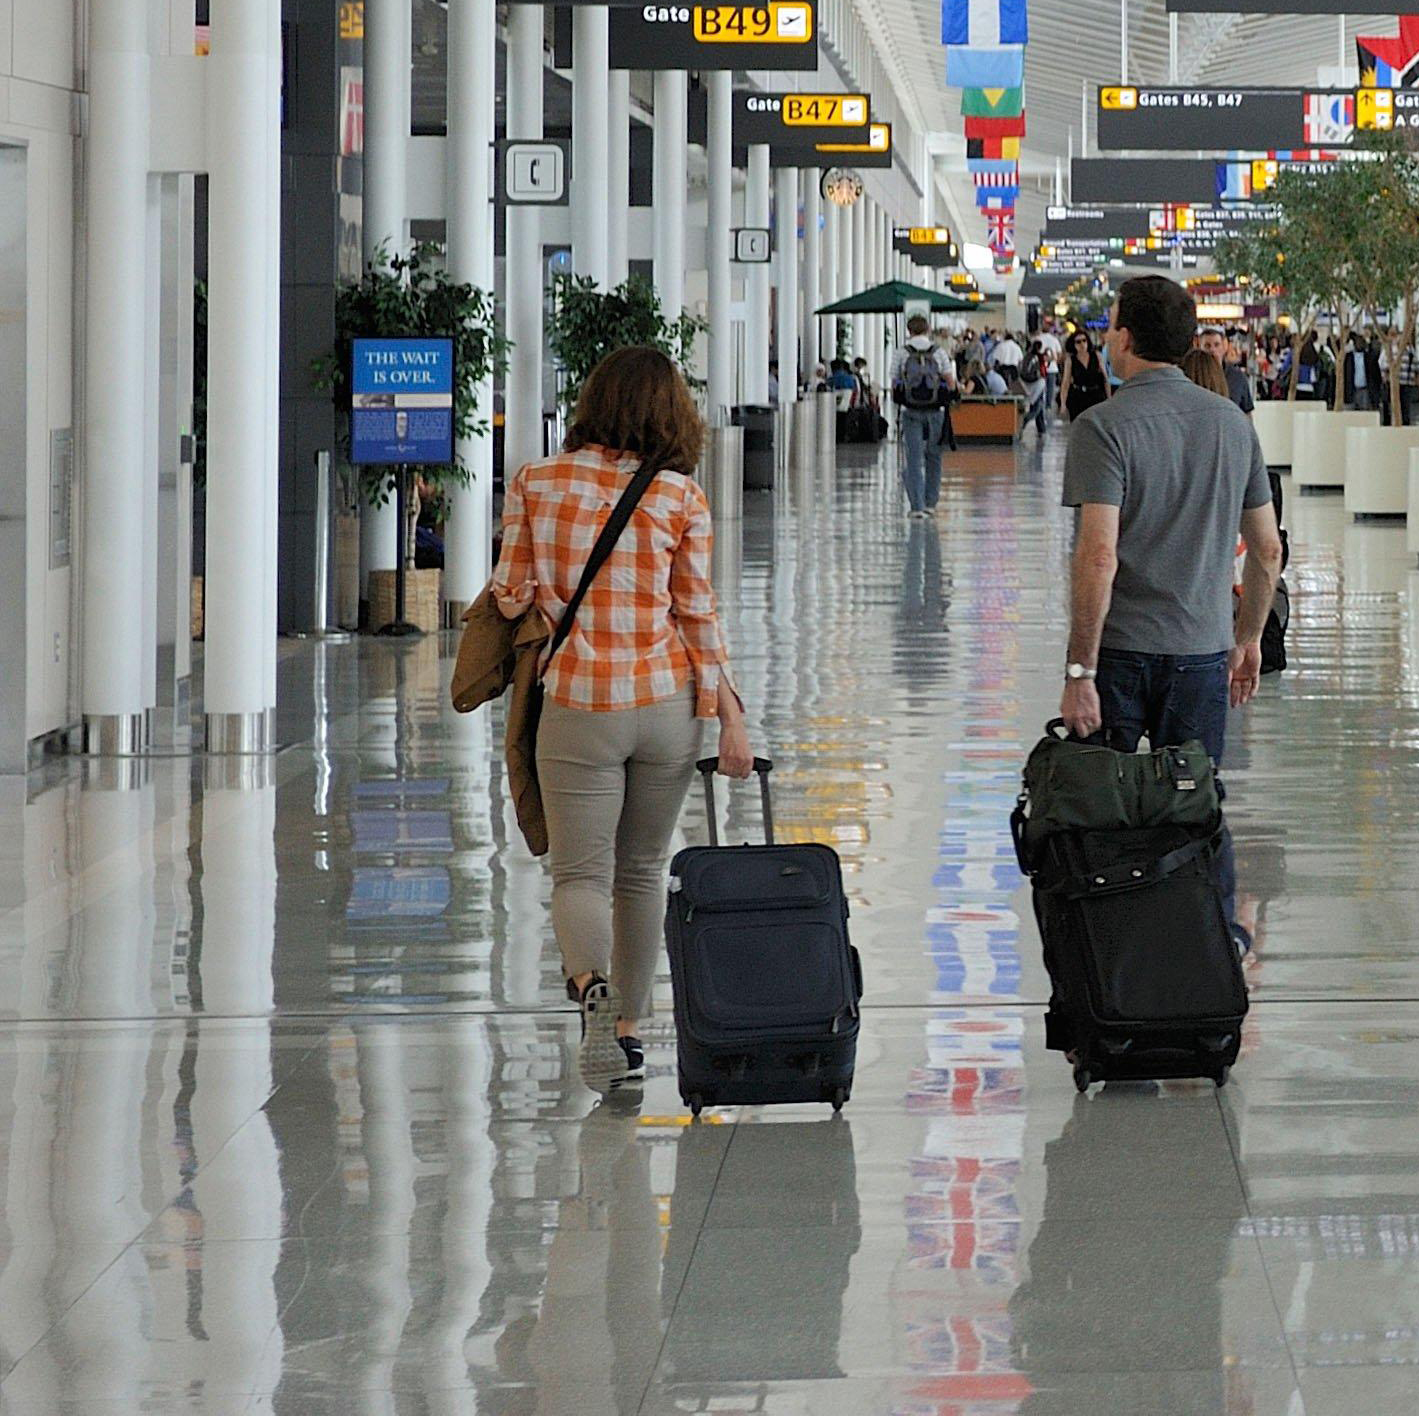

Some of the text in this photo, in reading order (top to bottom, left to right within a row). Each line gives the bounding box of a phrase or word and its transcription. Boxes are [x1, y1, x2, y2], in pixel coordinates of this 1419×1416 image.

[642, 5, 772, 36] Gate B49
[1139, 93, 1243, 109] Gates B45, B47
[746, 97, 838, 121] Gate B47
[1395, 114, 1407, 128] A
[364, 351, 440, 365] THE WAIT
[373, 369, 437, 384] IS OVER.
